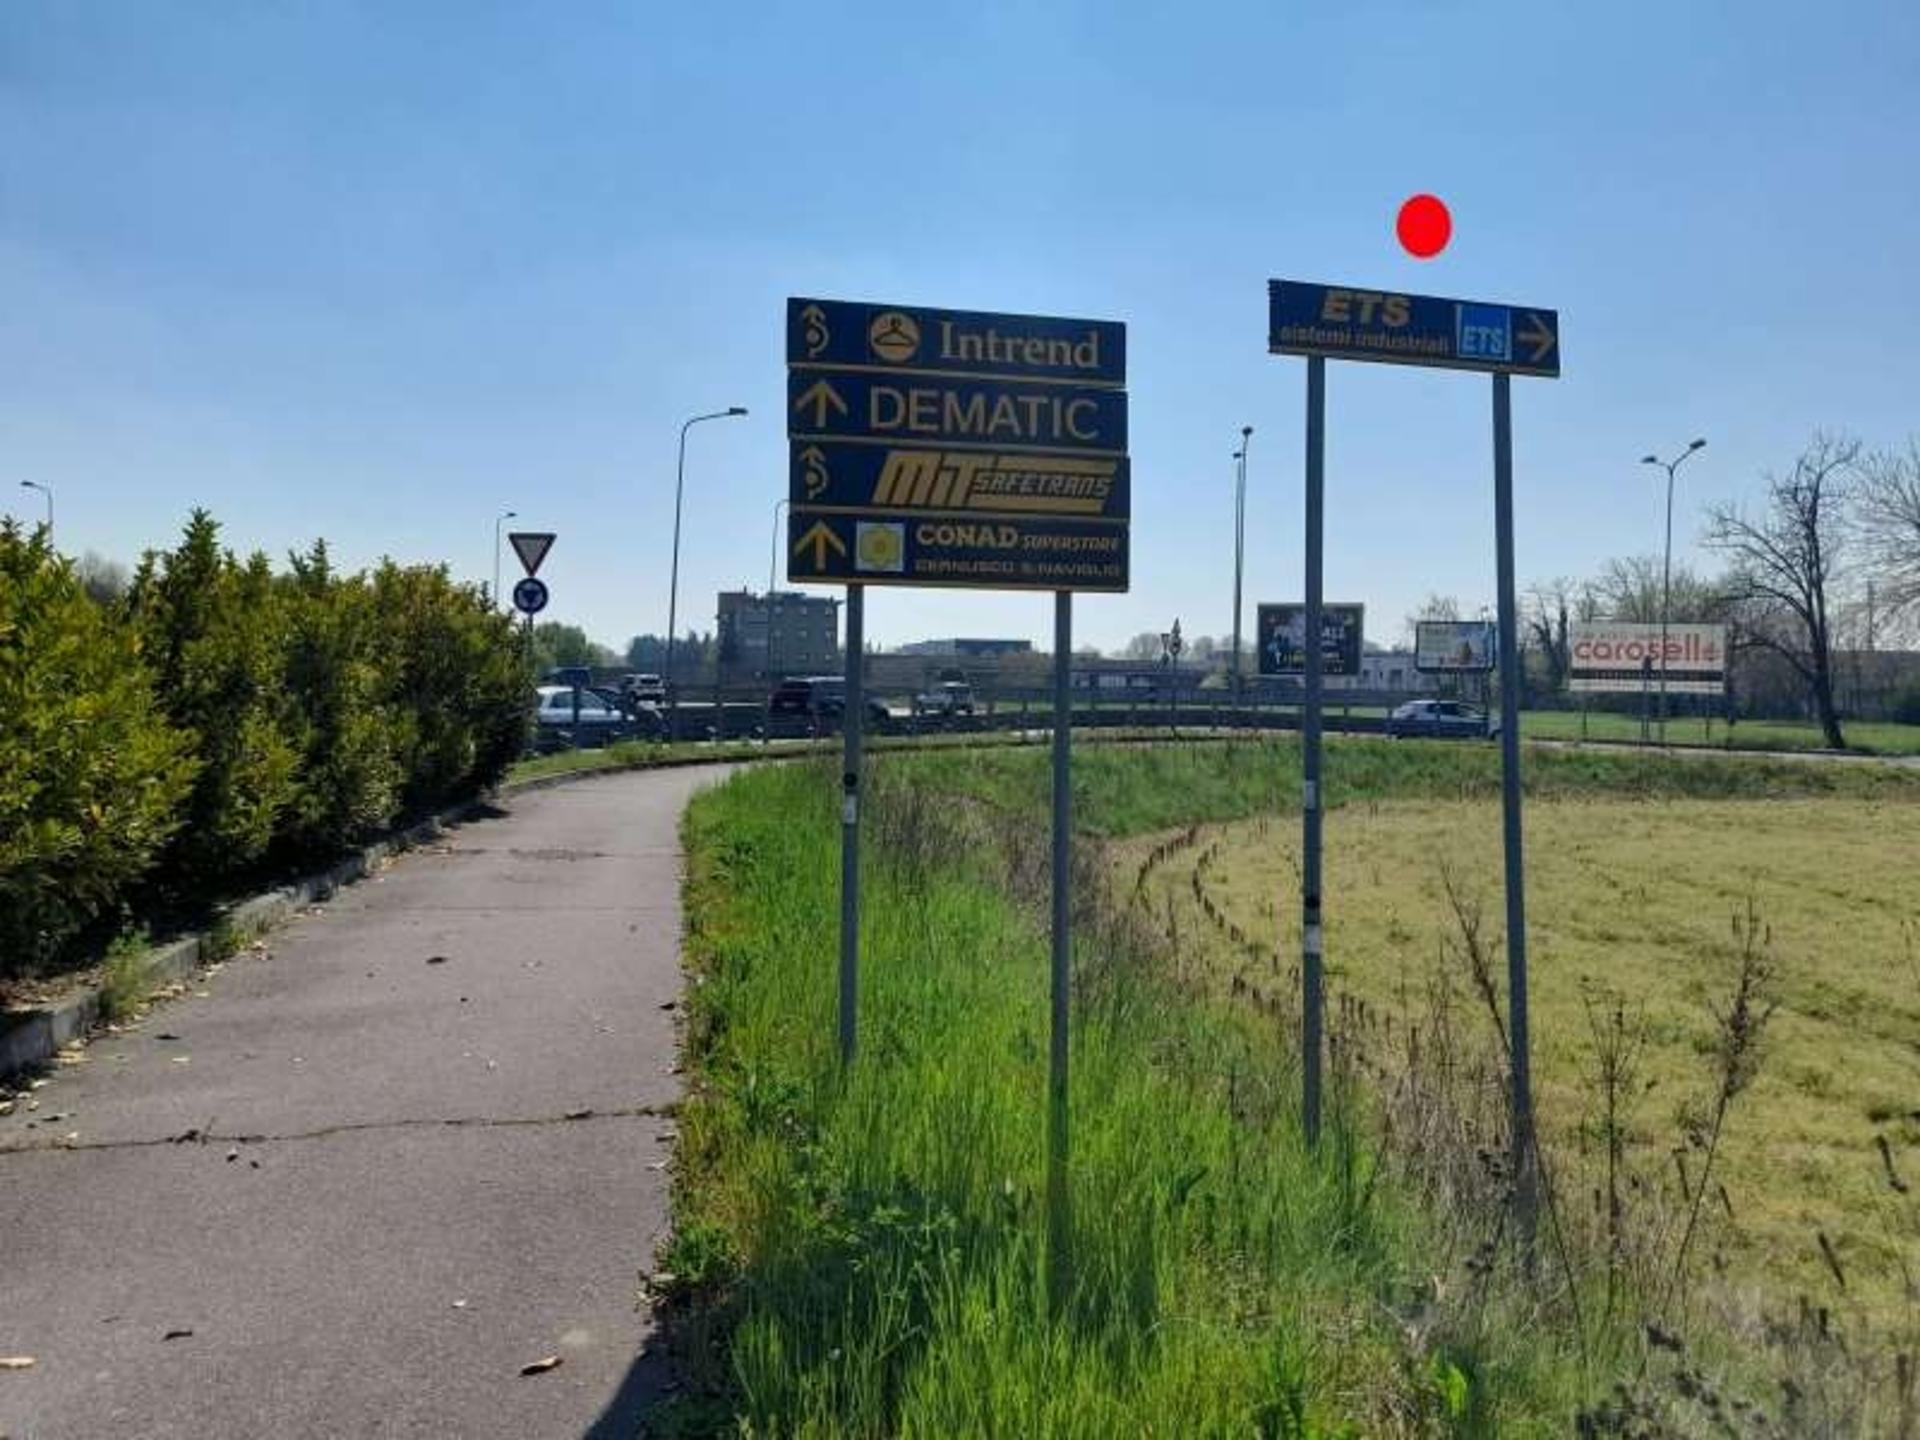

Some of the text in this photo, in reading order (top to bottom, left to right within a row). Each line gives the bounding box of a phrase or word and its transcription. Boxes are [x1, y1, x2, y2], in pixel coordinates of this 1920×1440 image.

[1320, 290, 1411, 327] ETS
[940, 321, 1100, 368] Intrend
[1463, 324, 1504, 355] ETS
[869, 386, 1099, 440] DEMATIC
[915, 525, 1019, 548] CONAD
